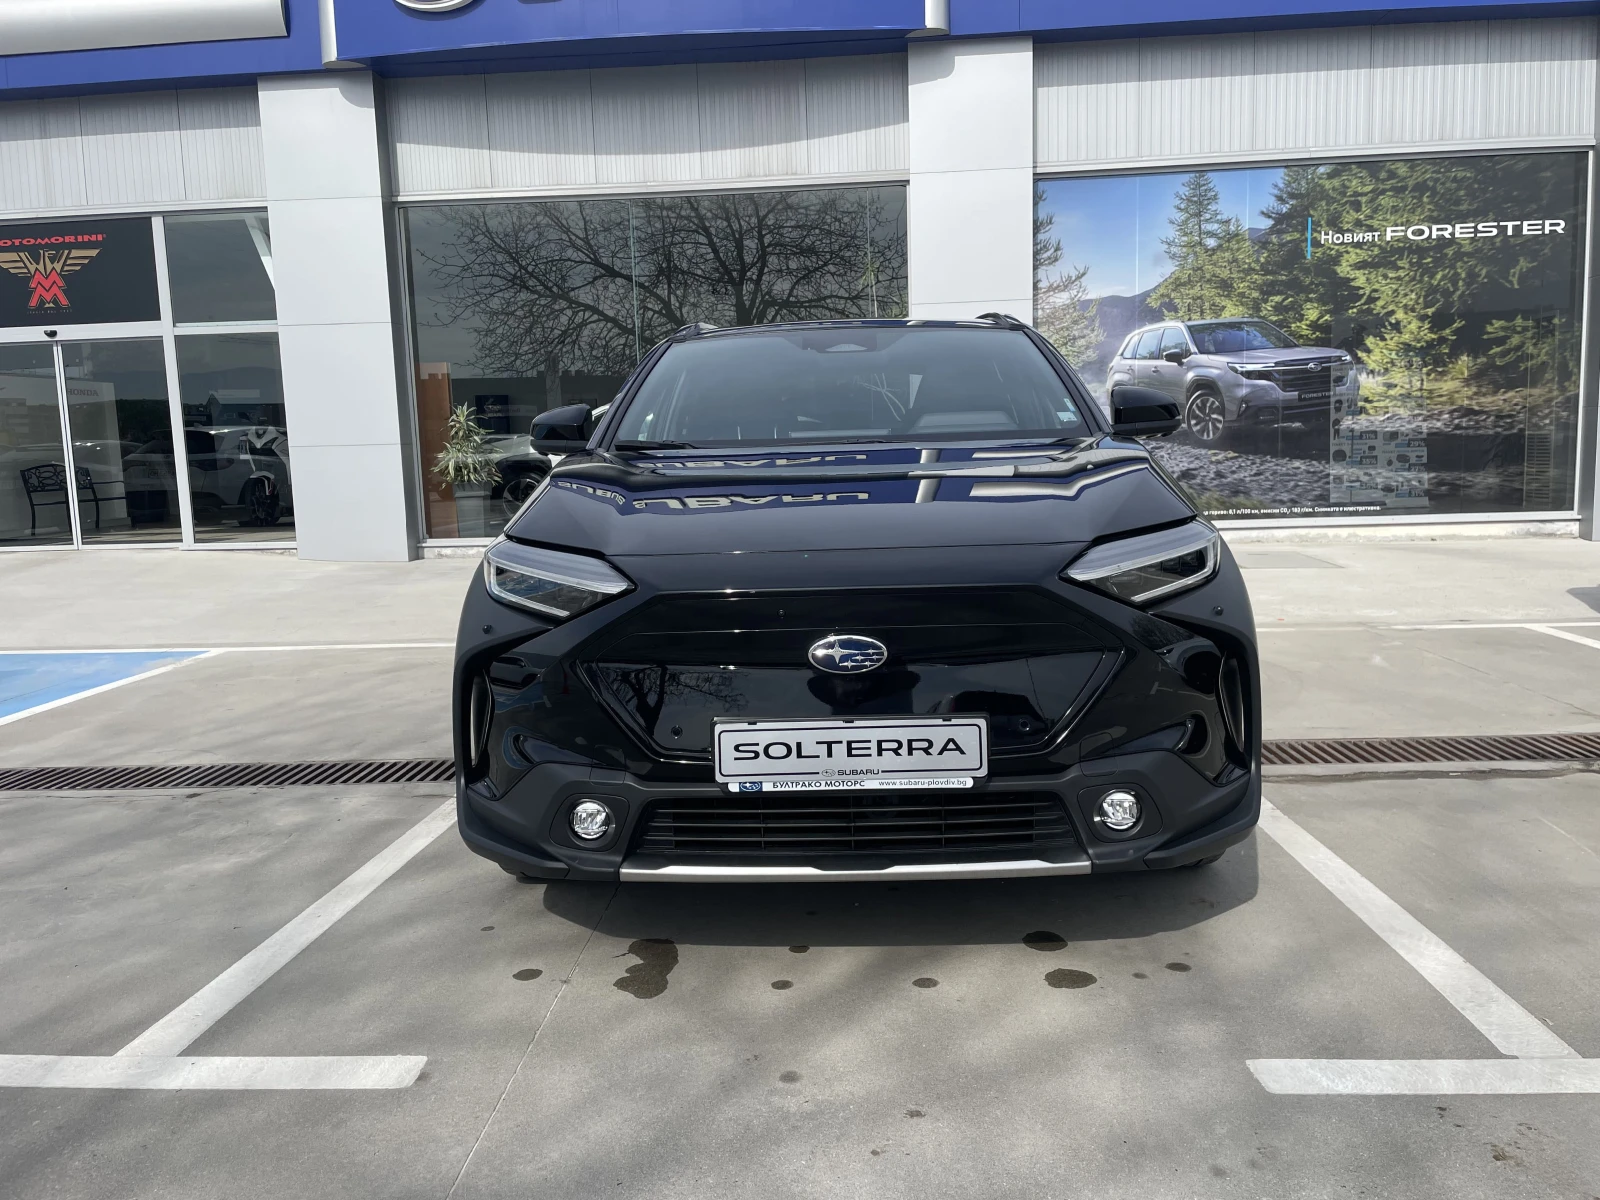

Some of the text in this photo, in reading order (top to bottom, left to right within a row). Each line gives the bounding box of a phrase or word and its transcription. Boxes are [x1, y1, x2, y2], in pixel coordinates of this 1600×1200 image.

[1320, 219, 1566, 244] Новият FORESTER
[0, 233, 103, 247] OTOMORINI
[733, 737, 967, 761] SOLTERRA
[837, 768, 880, 776] SUBARU
[772, 778, 967, 789] БУЛТРАКО МОТОРС www.subaru-plovdiv.bg
